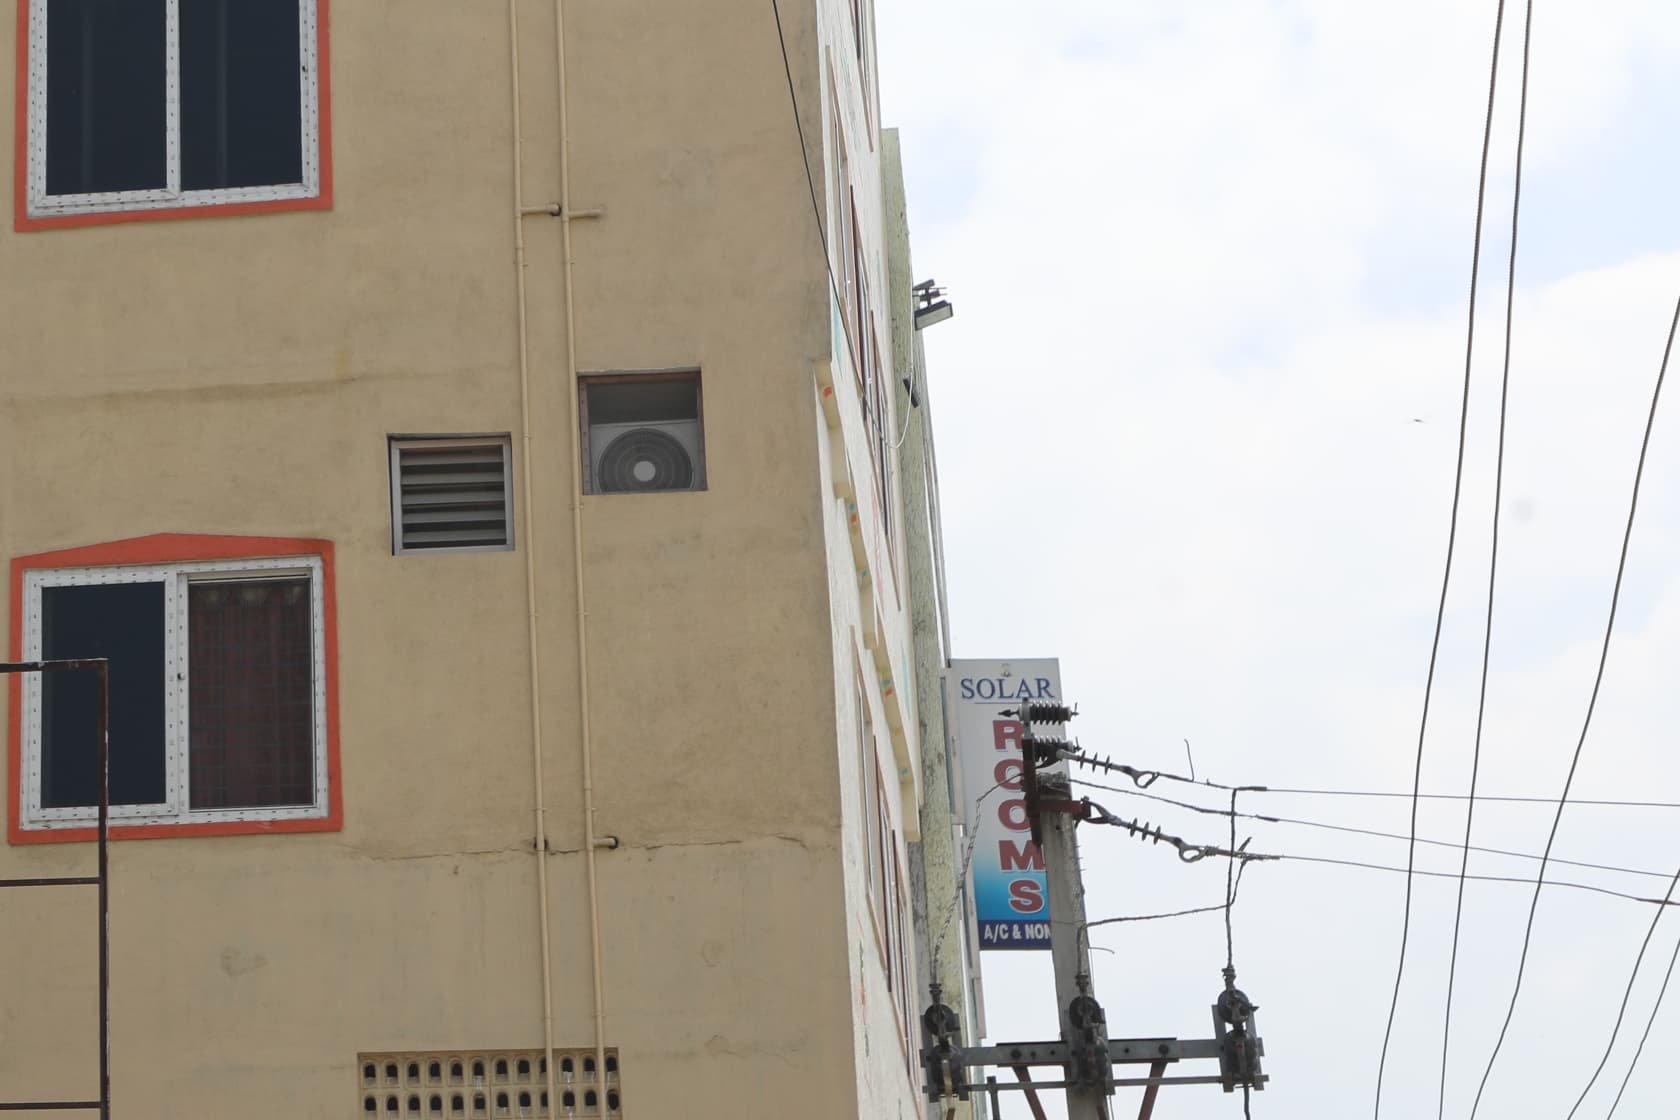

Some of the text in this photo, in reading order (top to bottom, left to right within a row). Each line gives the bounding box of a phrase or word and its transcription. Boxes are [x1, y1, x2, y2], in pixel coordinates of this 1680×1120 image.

[960, 678, 1056, 699] SOLAR
[983, 924, 1009, 943] A/C
[1012, 923, 1022, 940] &
